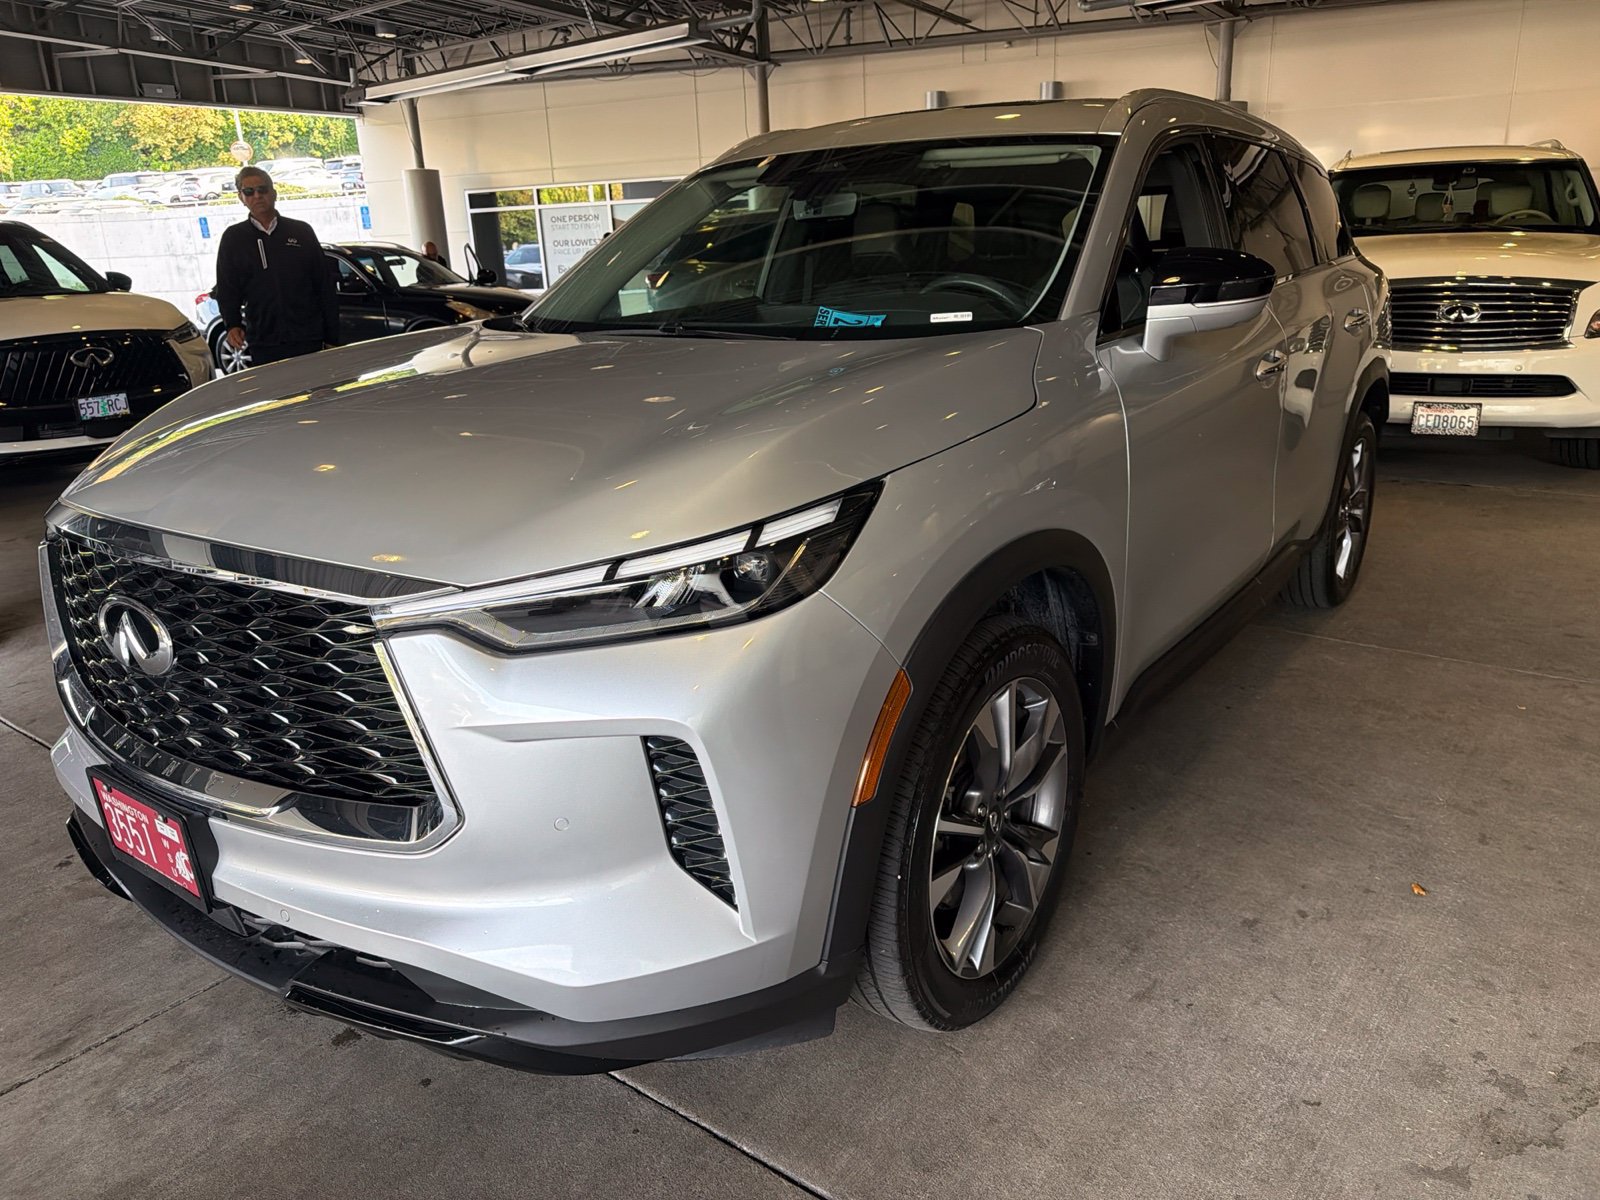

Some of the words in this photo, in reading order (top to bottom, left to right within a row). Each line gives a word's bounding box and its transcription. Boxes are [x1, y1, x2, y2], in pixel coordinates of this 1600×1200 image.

[568, 213, 600, 223] PERSON
[552, 239, 569, 248] OUR
[79, 400, 100, 417] 557
[106, 396, 129, 412] RCJ
[100, 790, 150, 825] WASHINGTON
[104, 801, 158, 865] 3551
